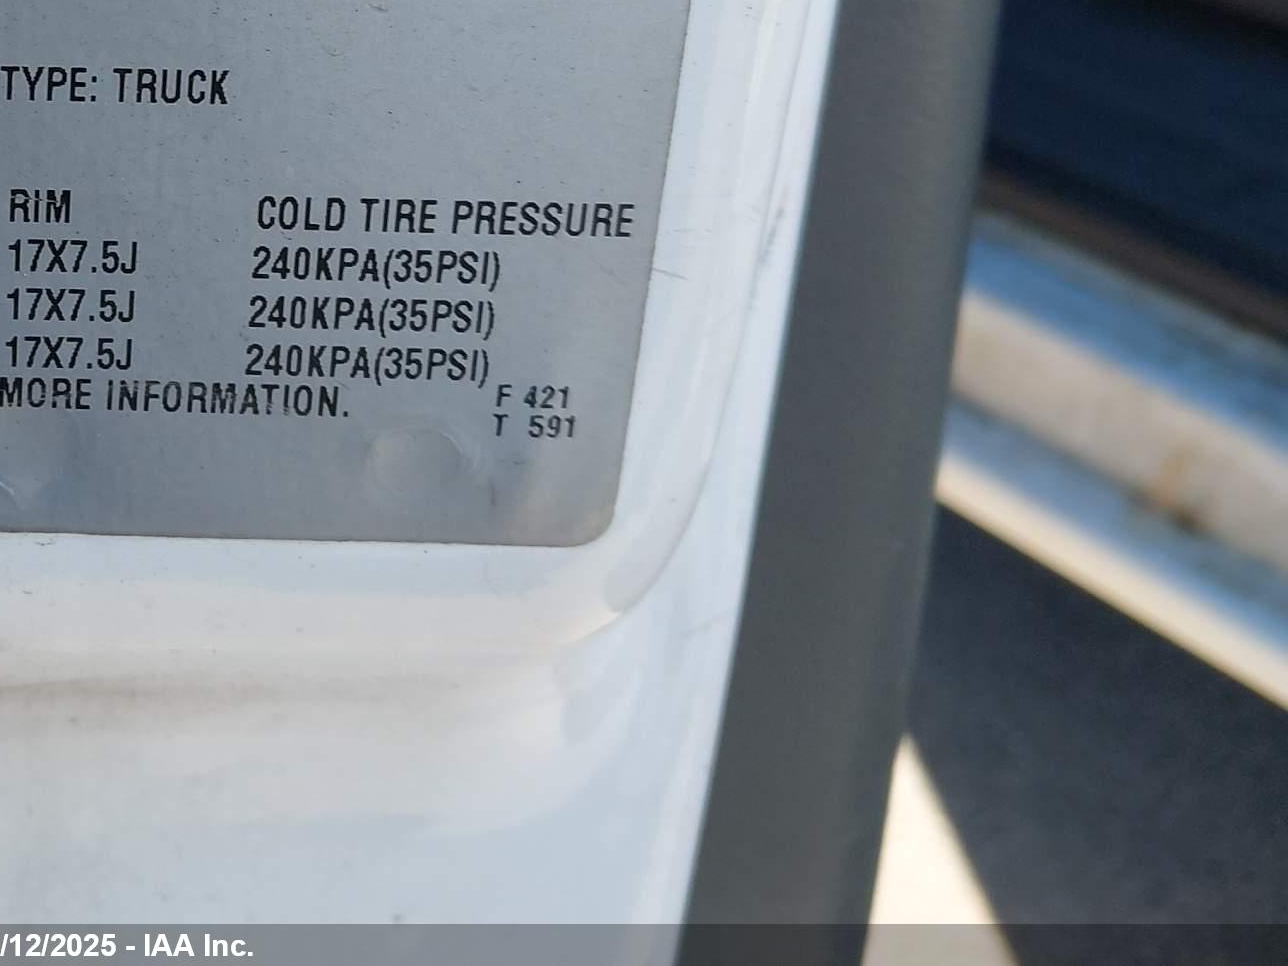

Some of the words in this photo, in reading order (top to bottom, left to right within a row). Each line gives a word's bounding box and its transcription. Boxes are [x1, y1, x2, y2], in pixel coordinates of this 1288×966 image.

[1, 66, 97, 102] TYPE:
[113, 68, 229, 104] TRUCK
[10, 189, 71, 223] RIM
[258, 196, 346, 231] COLD
[360, 198, 437, 233] TIRE
[452, 201, 634, 237] PRESSURE
[8, 239, 137, 274] 17X7.5J
[252, 246, 500, 292] 240KPA(35PSI)
[7, 288, 134, 322] 17X7.5J
[249, 295, 495, 340] 240KPA(35PSI)
[6, 336, 132, 370] 17X7.5J
[245, 344, 489, 388] 240KPA(35PSI)
[0, 377, 91, 409] MORE
[107, 380, 348, 417] INFORMATION.
[496, 384, 512, 407] F
[524, 385, 569, 408] 421
[493, 414, 508, 436] T
[528, 415, 575, 438] 591
